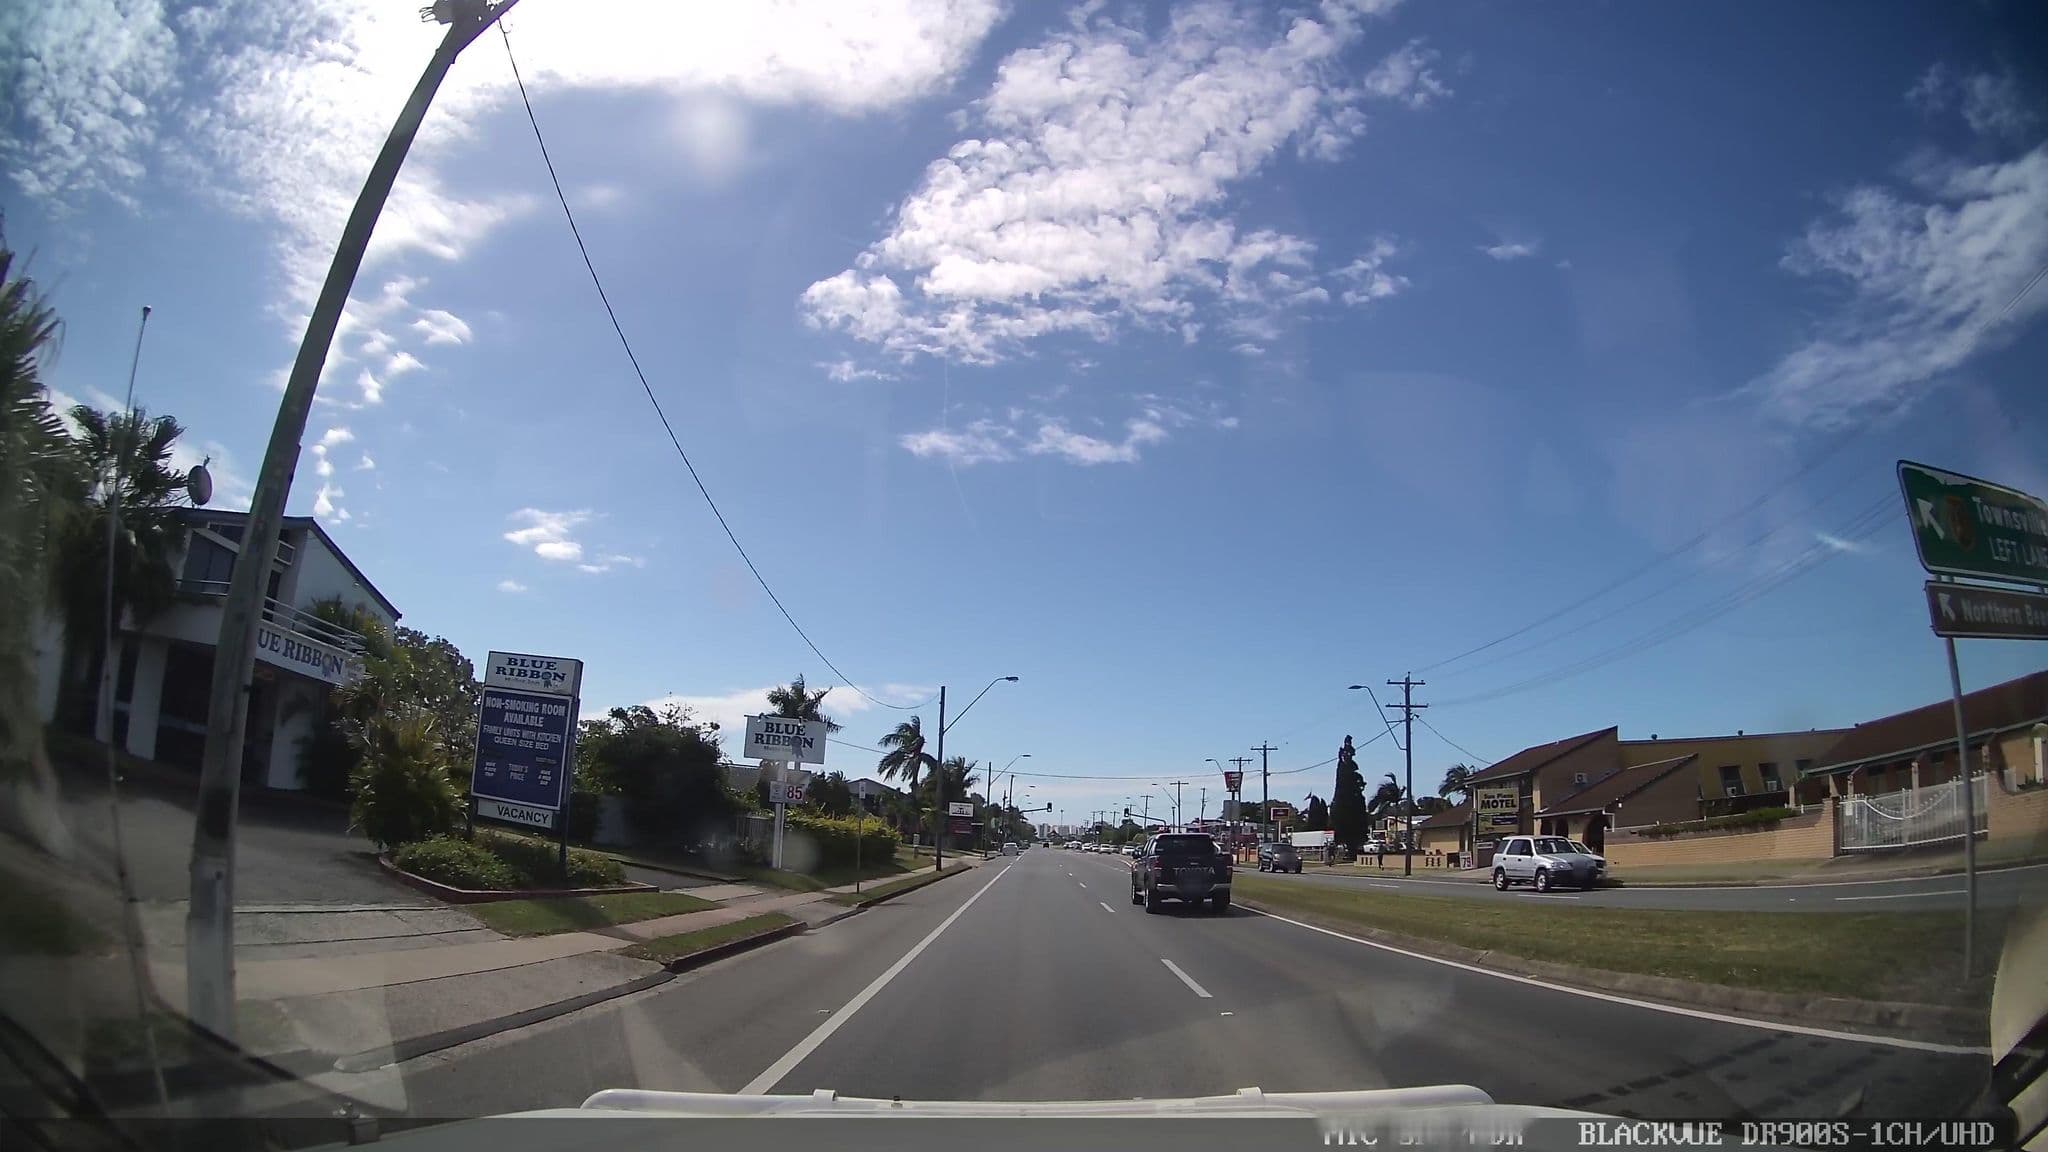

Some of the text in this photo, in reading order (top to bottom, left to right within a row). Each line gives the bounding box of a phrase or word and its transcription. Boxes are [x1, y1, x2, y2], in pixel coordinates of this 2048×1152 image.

[1988, 536, 2019, 563] LEFT
[1960, 598, 2022, 624] Northern
[257, 628, 281, 653] UE
[282, 638, 344, 675] RIBBON
[506, 657, 557, 670] BLUE
[495, 666, 566, 681] RIBBON
[485, 696, 566, 716] NON-SMOKING ROOM
[503, 712, 545, 727] AVAILABLE
[764, 722, 806, 736] BLUE
[494, 736, 517, 746] QUEEN
[519, 739, 534, 748] SIZE
[754, 733, 814, 749] RIBBON
[787, 785, 803, 800] 85
[1480, 799, 1517, 809] MOTEL
[497, 805, 549, 824] VACANCY
[1172, 866, 1216, 876] TOYOTA
